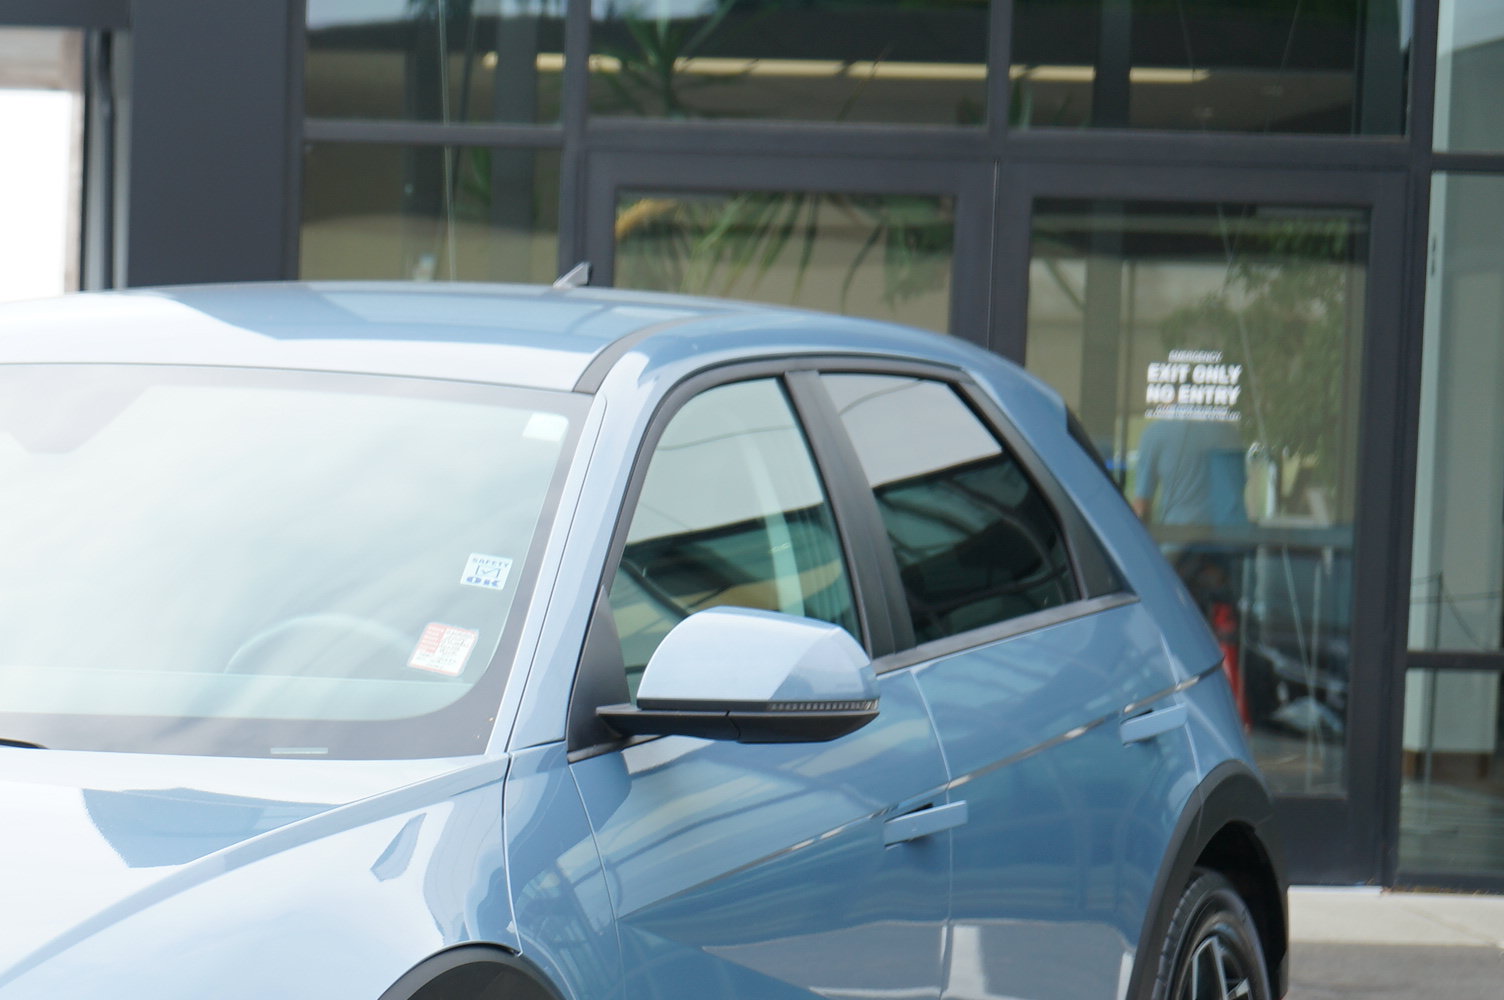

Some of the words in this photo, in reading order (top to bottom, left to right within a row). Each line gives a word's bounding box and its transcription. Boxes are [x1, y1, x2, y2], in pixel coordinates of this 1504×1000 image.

[1148, 362, 1190, 382] EXIT
[1193, 364, 1243, 385] ONLY
[1146, 384, 1175, 403] NO
[1178, 384, 1242, 405] ENTRY
[472, 558, 509, 568] SAFETY
[466, 576, 499, 587] OK
